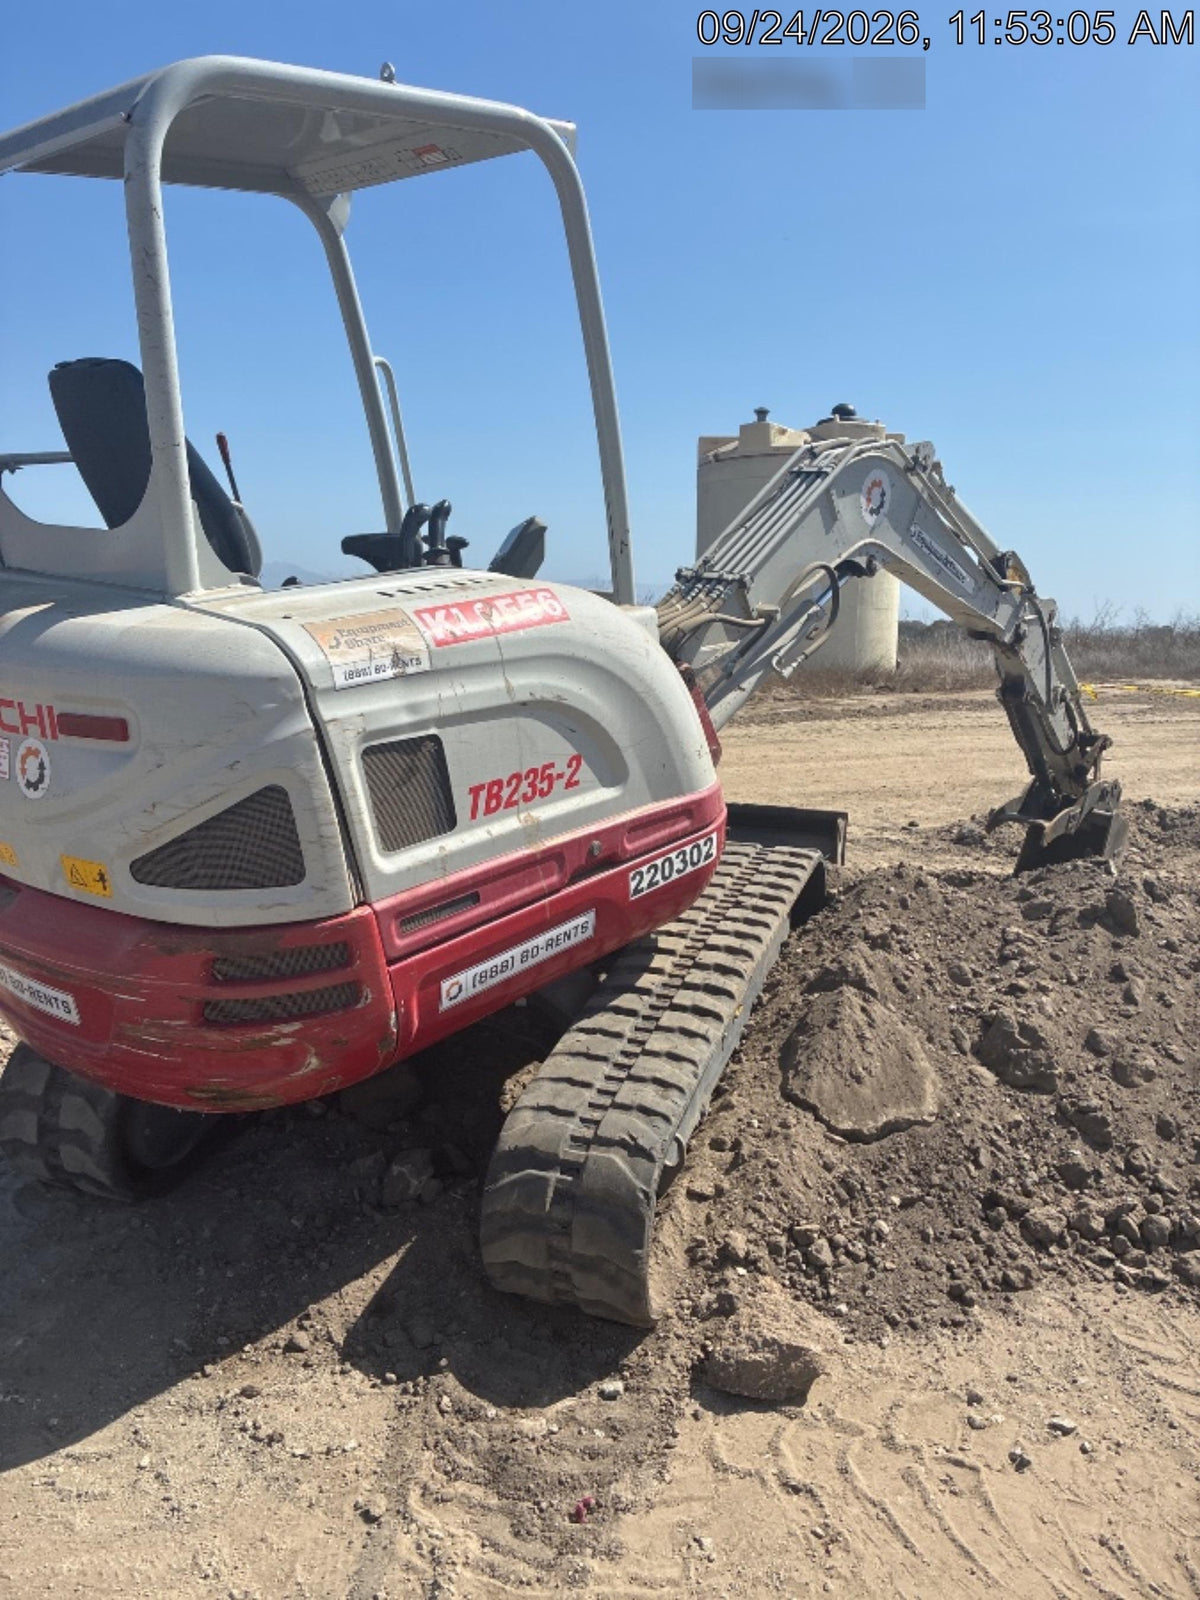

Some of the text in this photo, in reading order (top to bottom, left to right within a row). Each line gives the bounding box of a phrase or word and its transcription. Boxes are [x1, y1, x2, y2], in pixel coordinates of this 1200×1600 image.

[468, 754, 583, 821] TB235-2
[630, 836, 714, 898] 220302
[471, 919, 591, 990] (888) 80-RENTS
